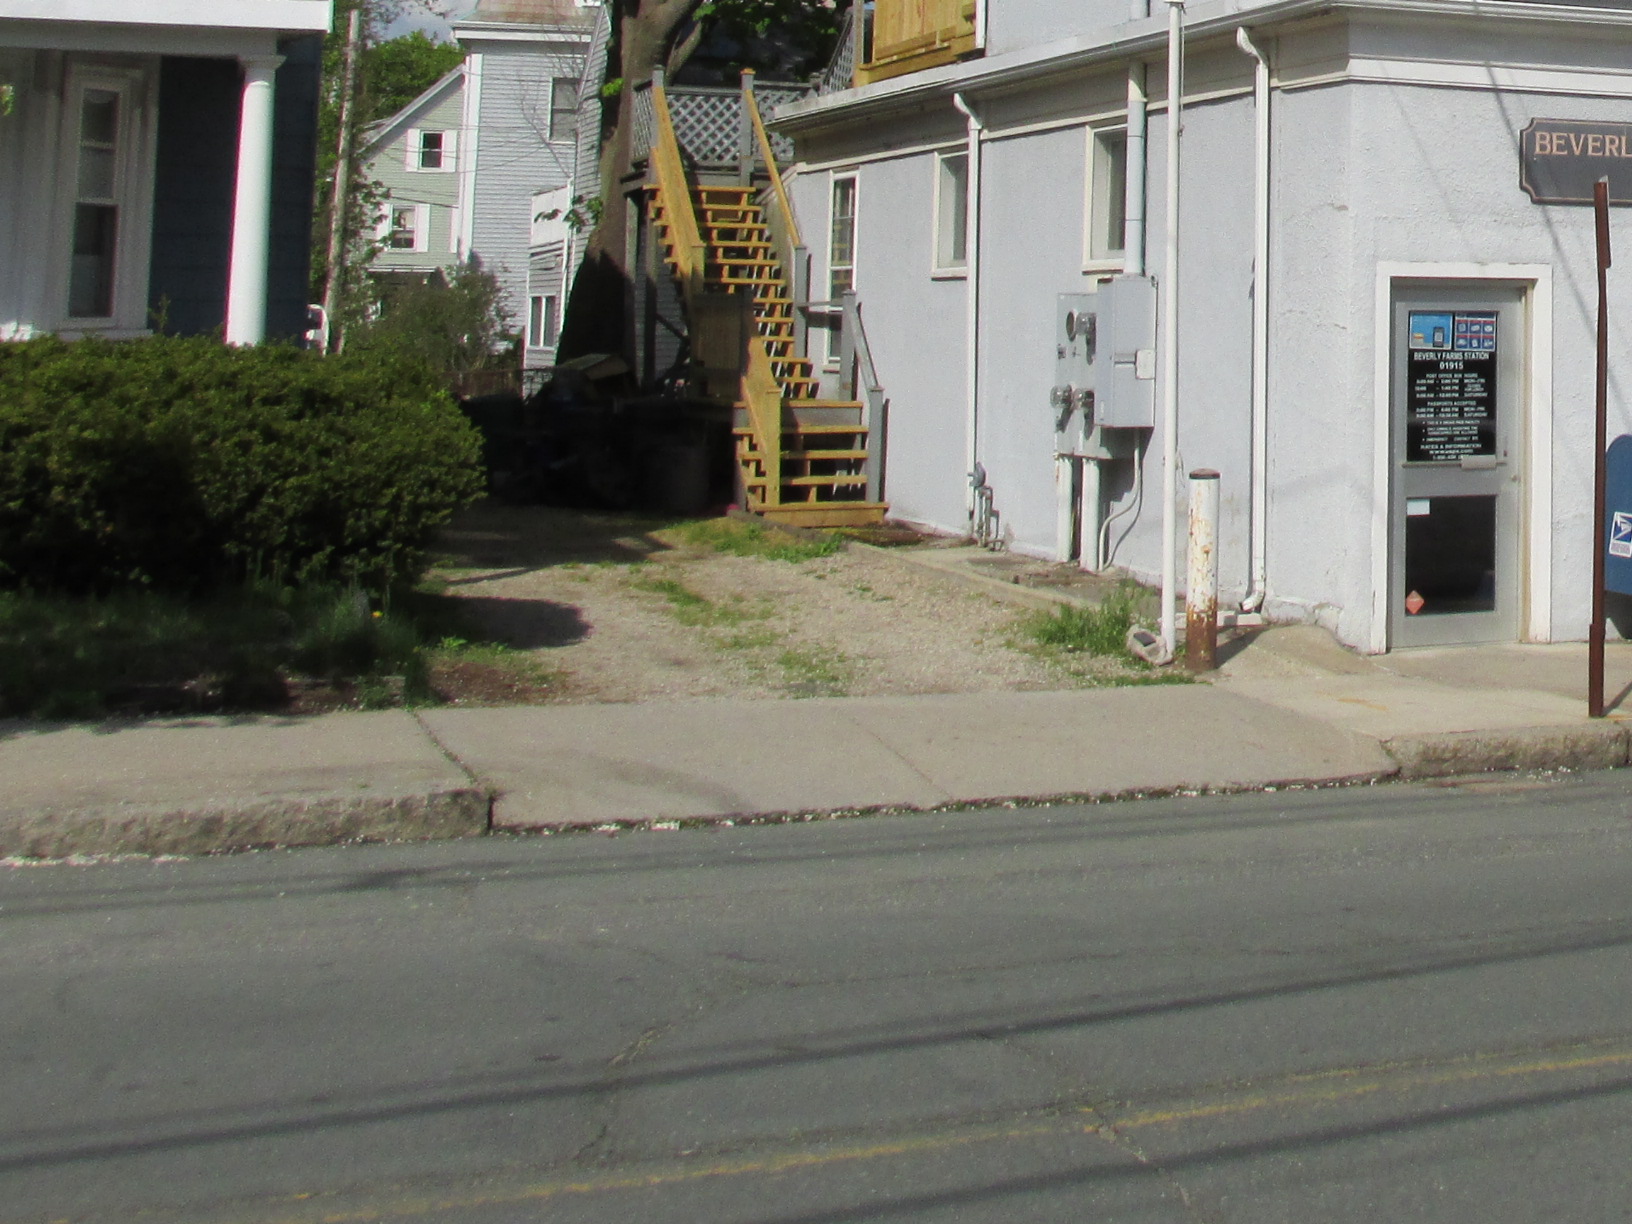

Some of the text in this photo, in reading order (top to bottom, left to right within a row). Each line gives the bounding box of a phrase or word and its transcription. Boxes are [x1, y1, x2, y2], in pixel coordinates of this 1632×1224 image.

[1413, 351, 1489, 360] BEVERLY FARMS STATION
[1439, 361, 1464, 370] 01915
